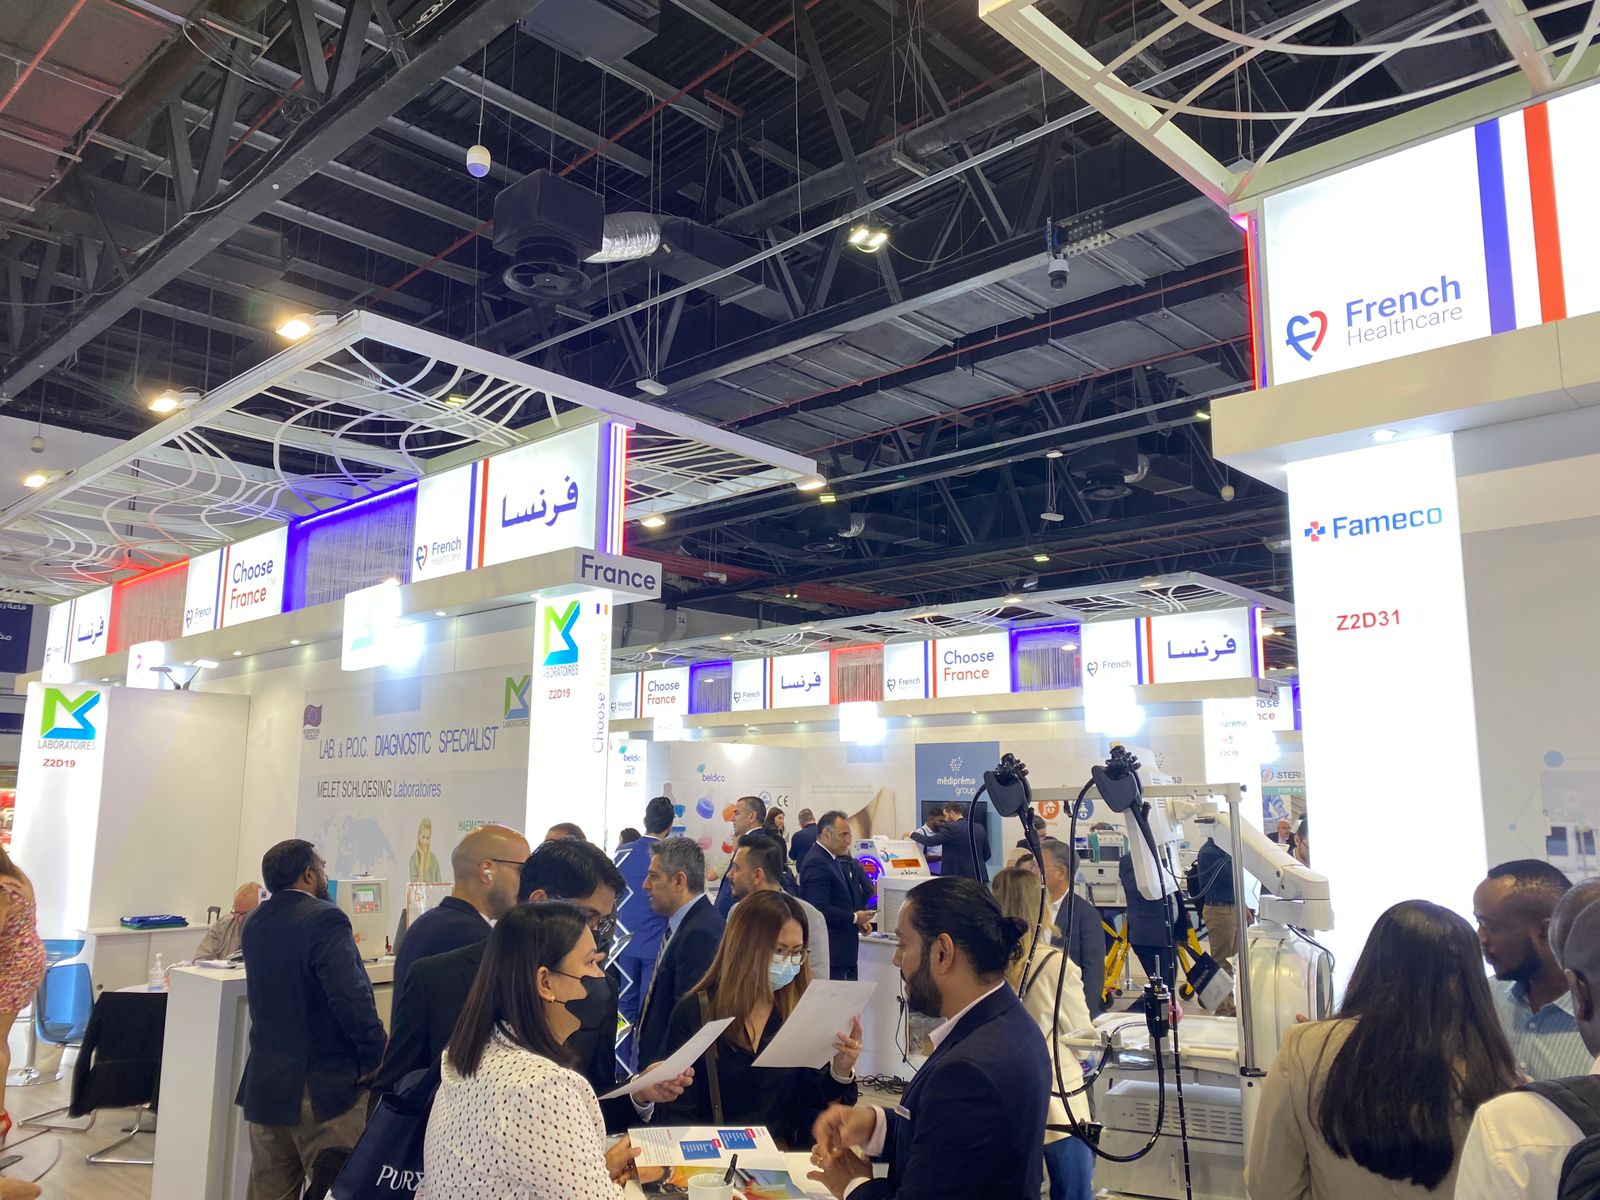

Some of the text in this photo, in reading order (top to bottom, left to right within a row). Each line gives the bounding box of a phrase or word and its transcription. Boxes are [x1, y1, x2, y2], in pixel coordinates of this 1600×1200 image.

[1346, 275, 1461, 327] French
[1347, 306, 1463, 347] Healthcare
[501, 476, 579, 528] فرنسا
[1333, 507, 1442, 539] Fameco
[432, 536, 462, 556] French
[233, 559, 274, 584] Choose
[581, 554, 657, 591] France
[230, 586, 267, 609] France
[194, 606, 212, 618] French
[1336, 609, 1400, 631] Z2D31
[77, 615, 104, 645] فرنسا
[1167, 634, 1237, 662] فرنسا
[943, 650, 995, 665] Choose
[1102, 659, 1132, 670] French
[781, 671, 821, 692] فرنسا
[898, 677, 921, 686] French
[943, 667, 990, 681] France
[548, 688, 571, 700] Z2D19
[647, 680, 680, 692] Choose
[742, 690, 761, 699] French
[647, 694, 677, 705] France
[503, 719, 530, 729] LABORATOIRES
[592, 692, 606, 754] Choose
[37, 739, 97, 751] LABORATOIRES
[319, 738, 336, 759] LAB.
[345, 735, 368, 758] P.O.C.
[374, 730, 432, 757] DIAGNOSTIC
[438, 726, 499, 753] SPECIALIST
[42, 758, 76, 768] Z2D19
[702, 774, 726, 783] beldico
[936, 776, 977, 786] médipréma
[316, 778, 442, 798] MELET SCHLOESING Laboratoires
[955, 786, 977, 797] group
